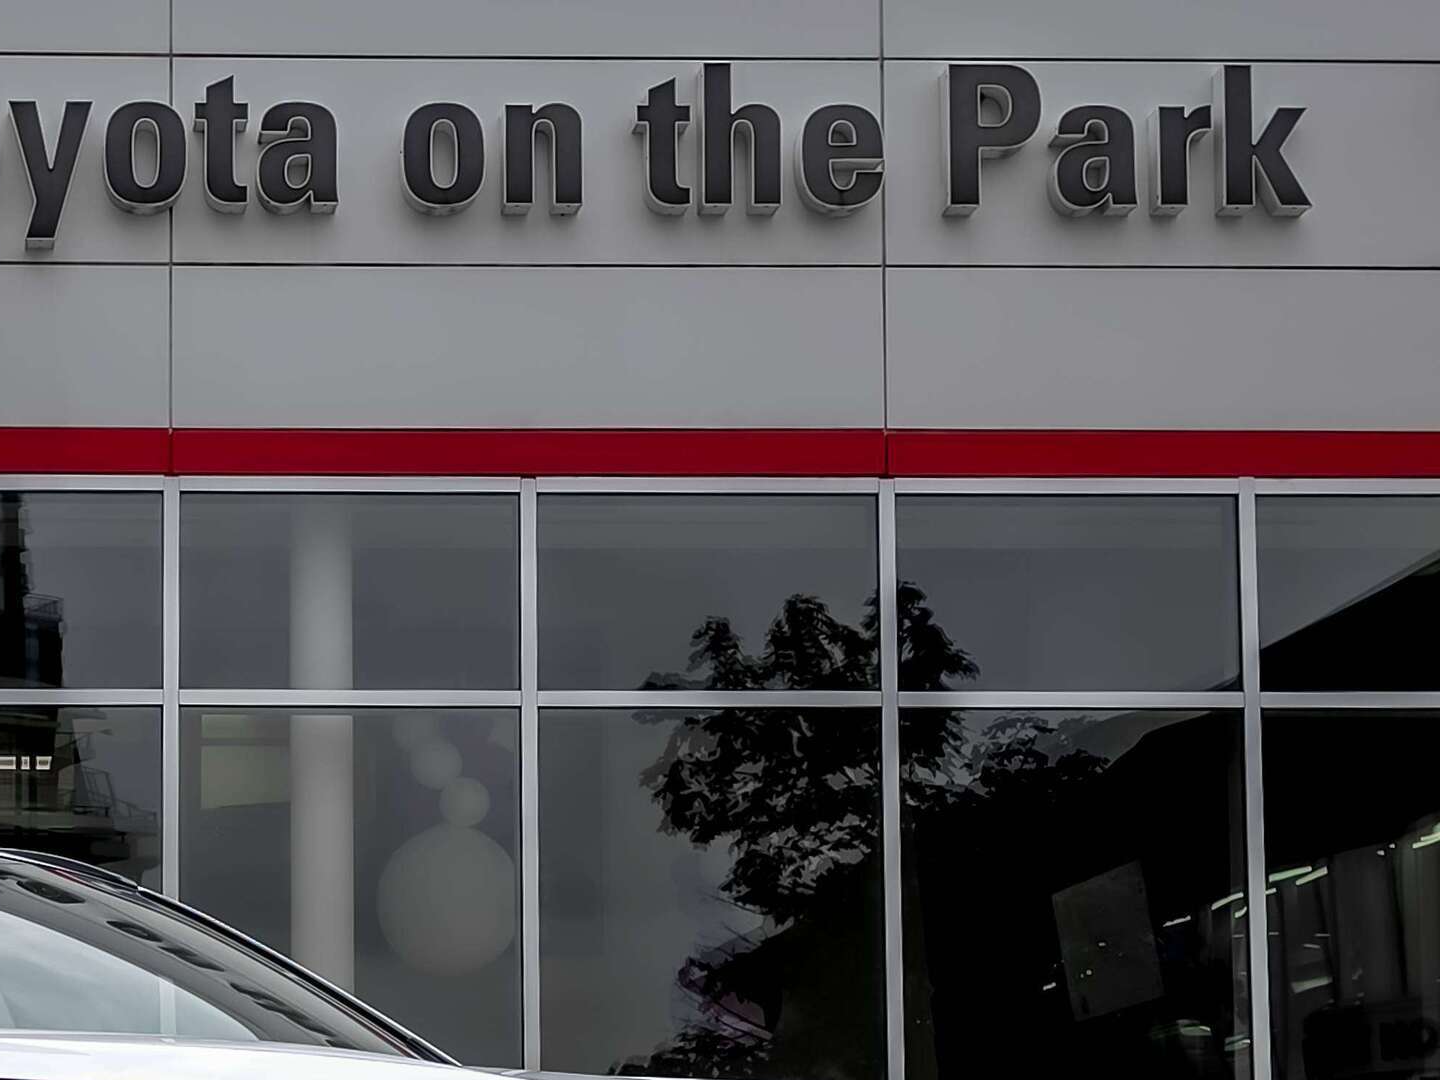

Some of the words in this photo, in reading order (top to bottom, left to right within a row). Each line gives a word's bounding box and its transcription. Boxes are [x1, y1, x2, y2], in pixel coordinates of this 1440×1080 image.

[402, 103, 584, 220] on
[634, 63, 885, 223] the
[943, 64, 1313, 224] Park
